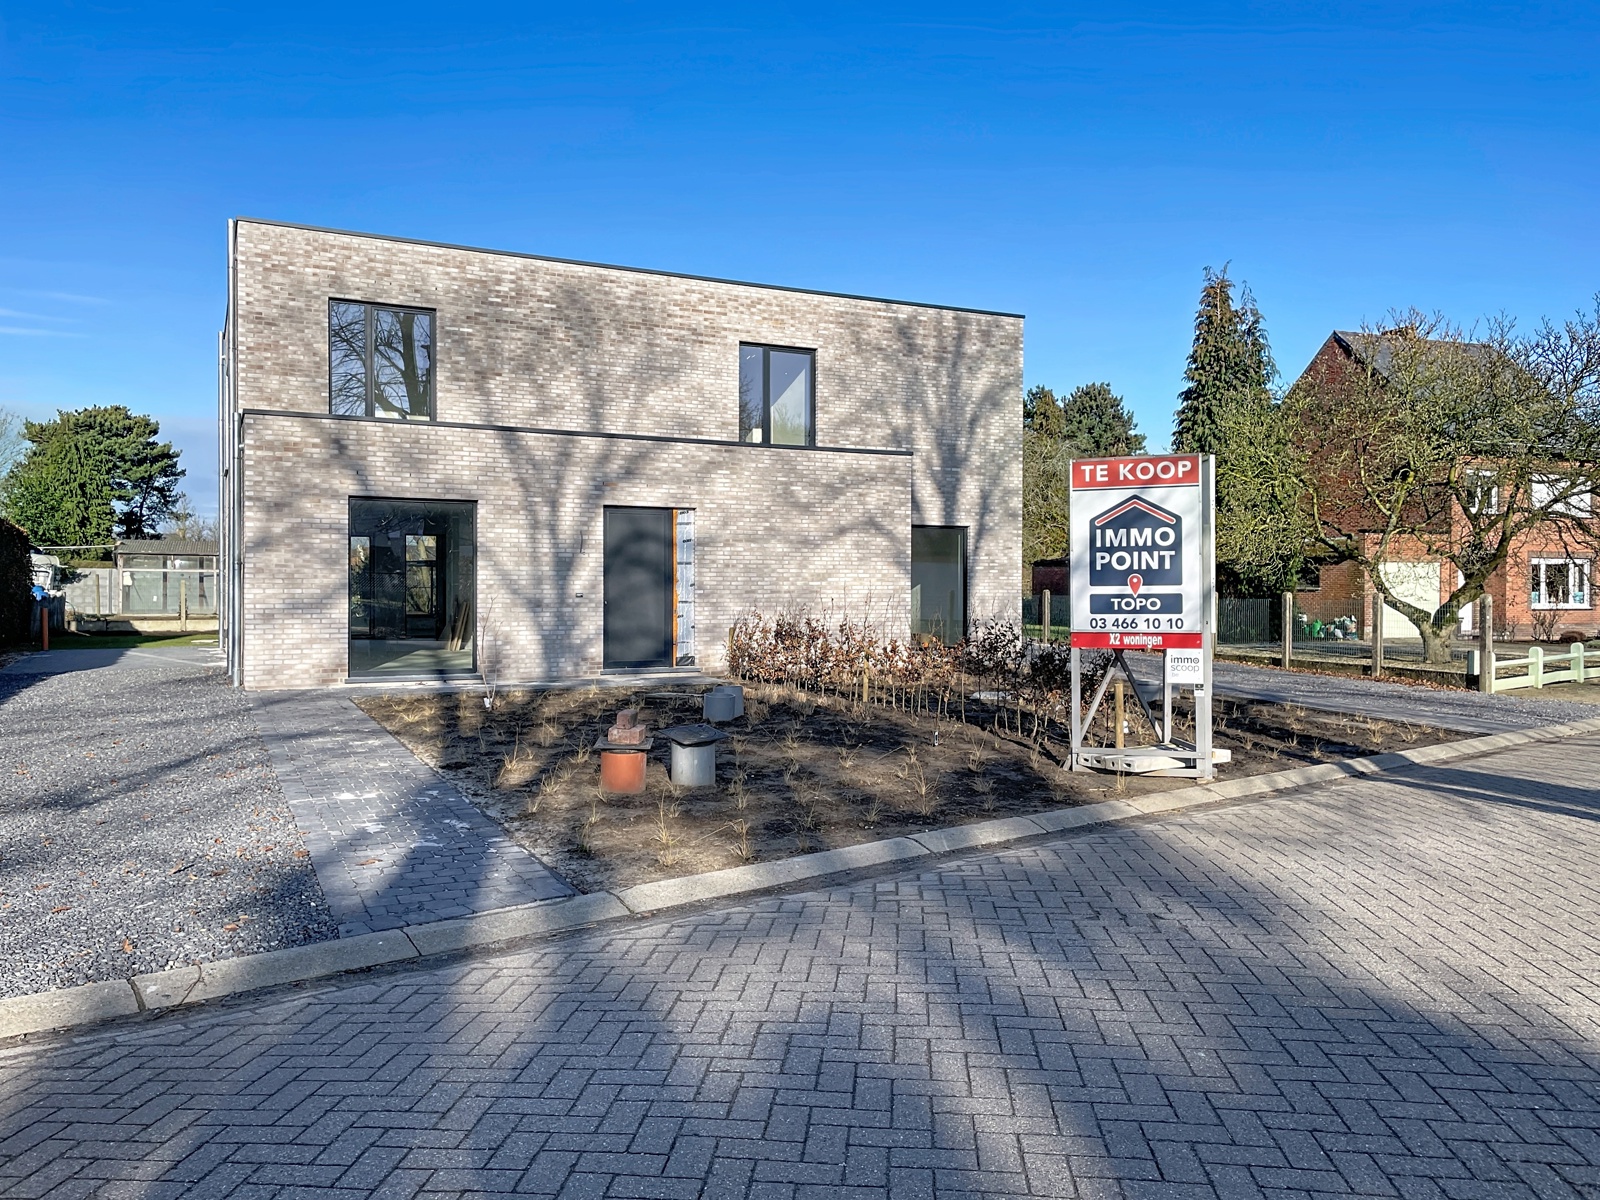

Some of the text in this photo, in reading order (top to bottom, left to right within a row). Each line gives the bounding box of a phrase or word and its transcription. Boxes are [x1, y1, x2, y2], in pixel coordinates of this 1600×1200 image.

[1081, 461, 1192, 482] TE KOOP
[1095, 526, 1176, 548] IMMO
[1095, 551, 1176, 571] POINT
[1111, 597, 1161, 611] TOPO
[1089, 617, 1184, 630] 03 466 10 10
[1109, 633, 1163, 648] X2 woningen
[1170, 654, 1200, 664] immo
[1170, 664, 1200, 673] scoop
